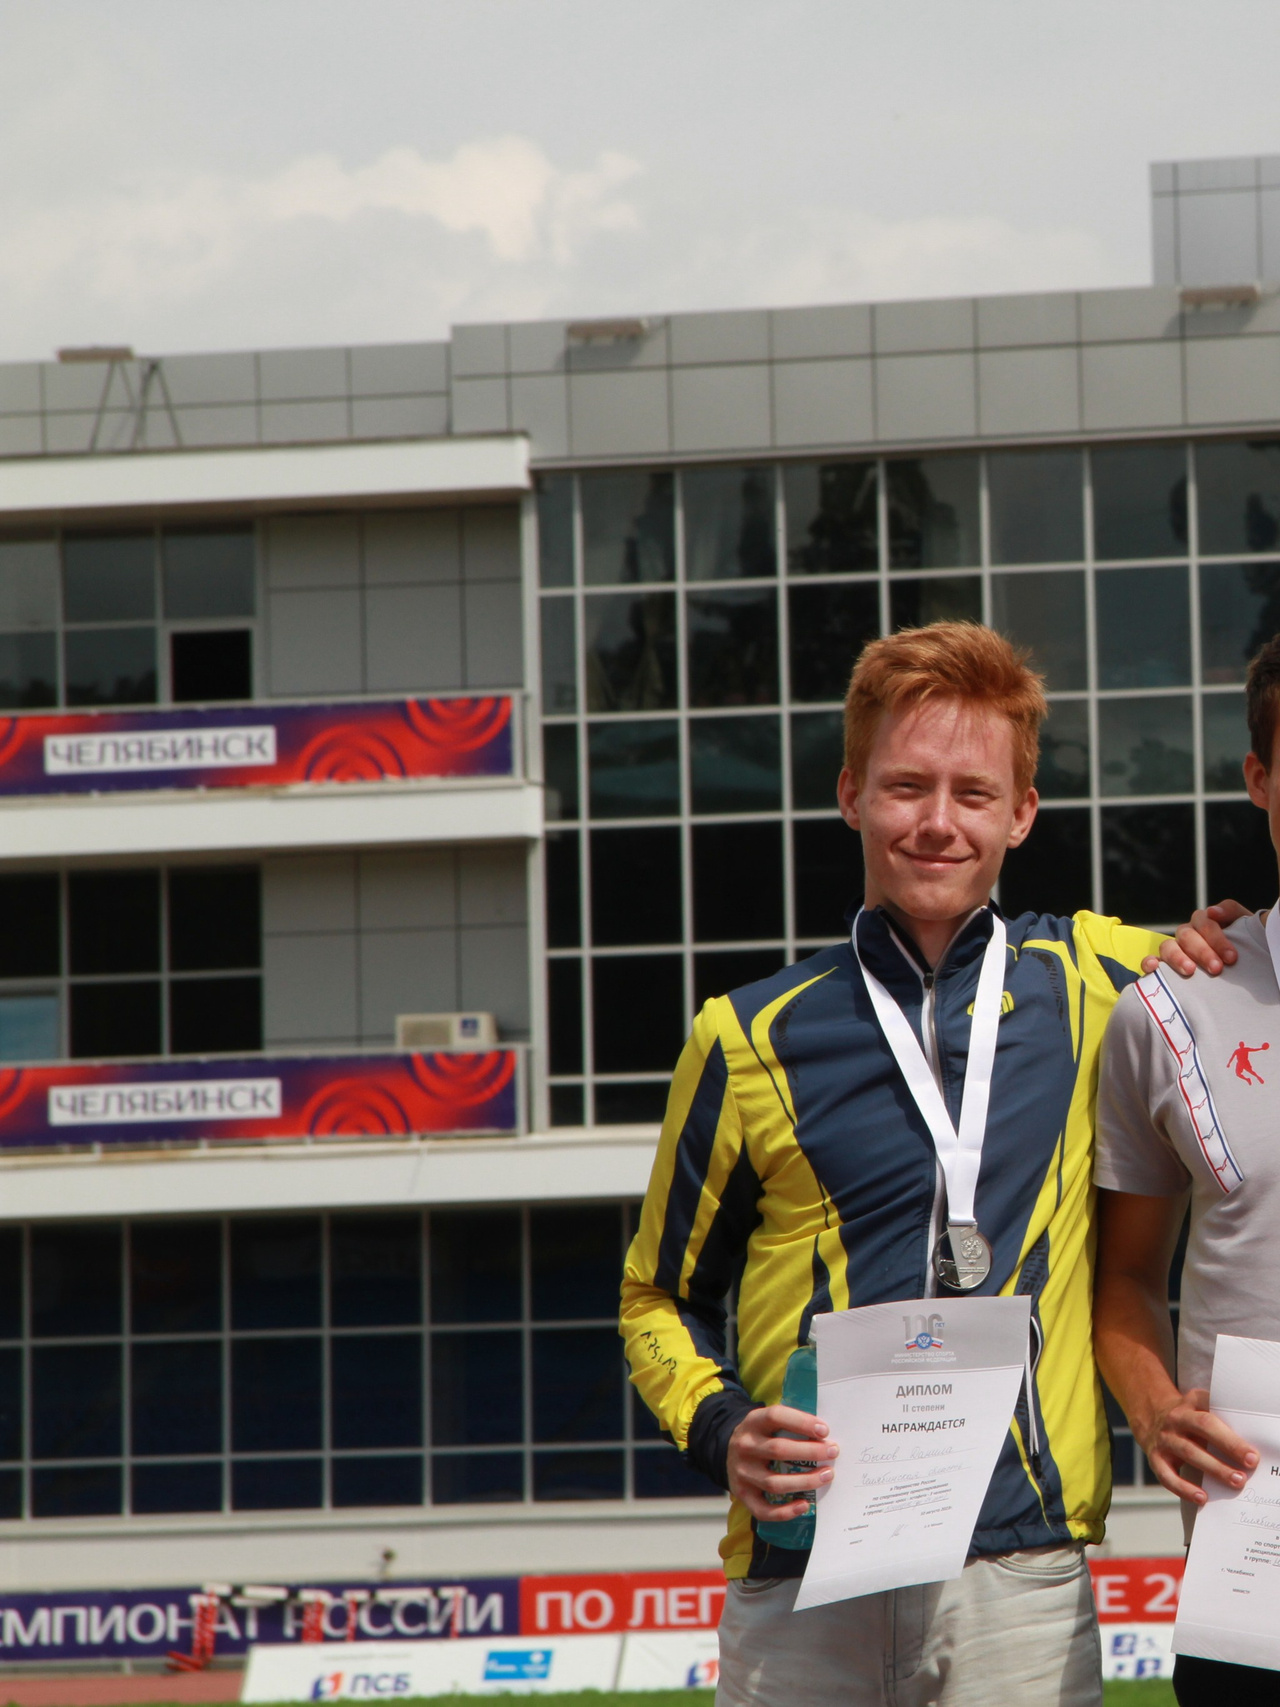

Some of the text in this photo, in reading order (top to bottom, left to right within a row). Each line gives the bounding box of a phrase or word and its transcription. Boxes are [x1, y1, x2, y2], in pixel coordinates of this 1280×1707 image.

[50, 733, 269, 766] ЧЕЛЯБИНСК
[55, 1085, 274, 1117] ЧЕЛЯБИНСК
[896, 1384, 953, 1399] ДИПЛОМ
[902, 1403, 945, 1412] II степени
[882, 1418, 965, 1433] НАГРАЖДАЕТСЯ
[536, 1585, 727, 1630] ПО ЛЕГ
[0, 1603, 257, 1645] МПИОНАТ
[350, 1672, 411, 1694] ПСБ
